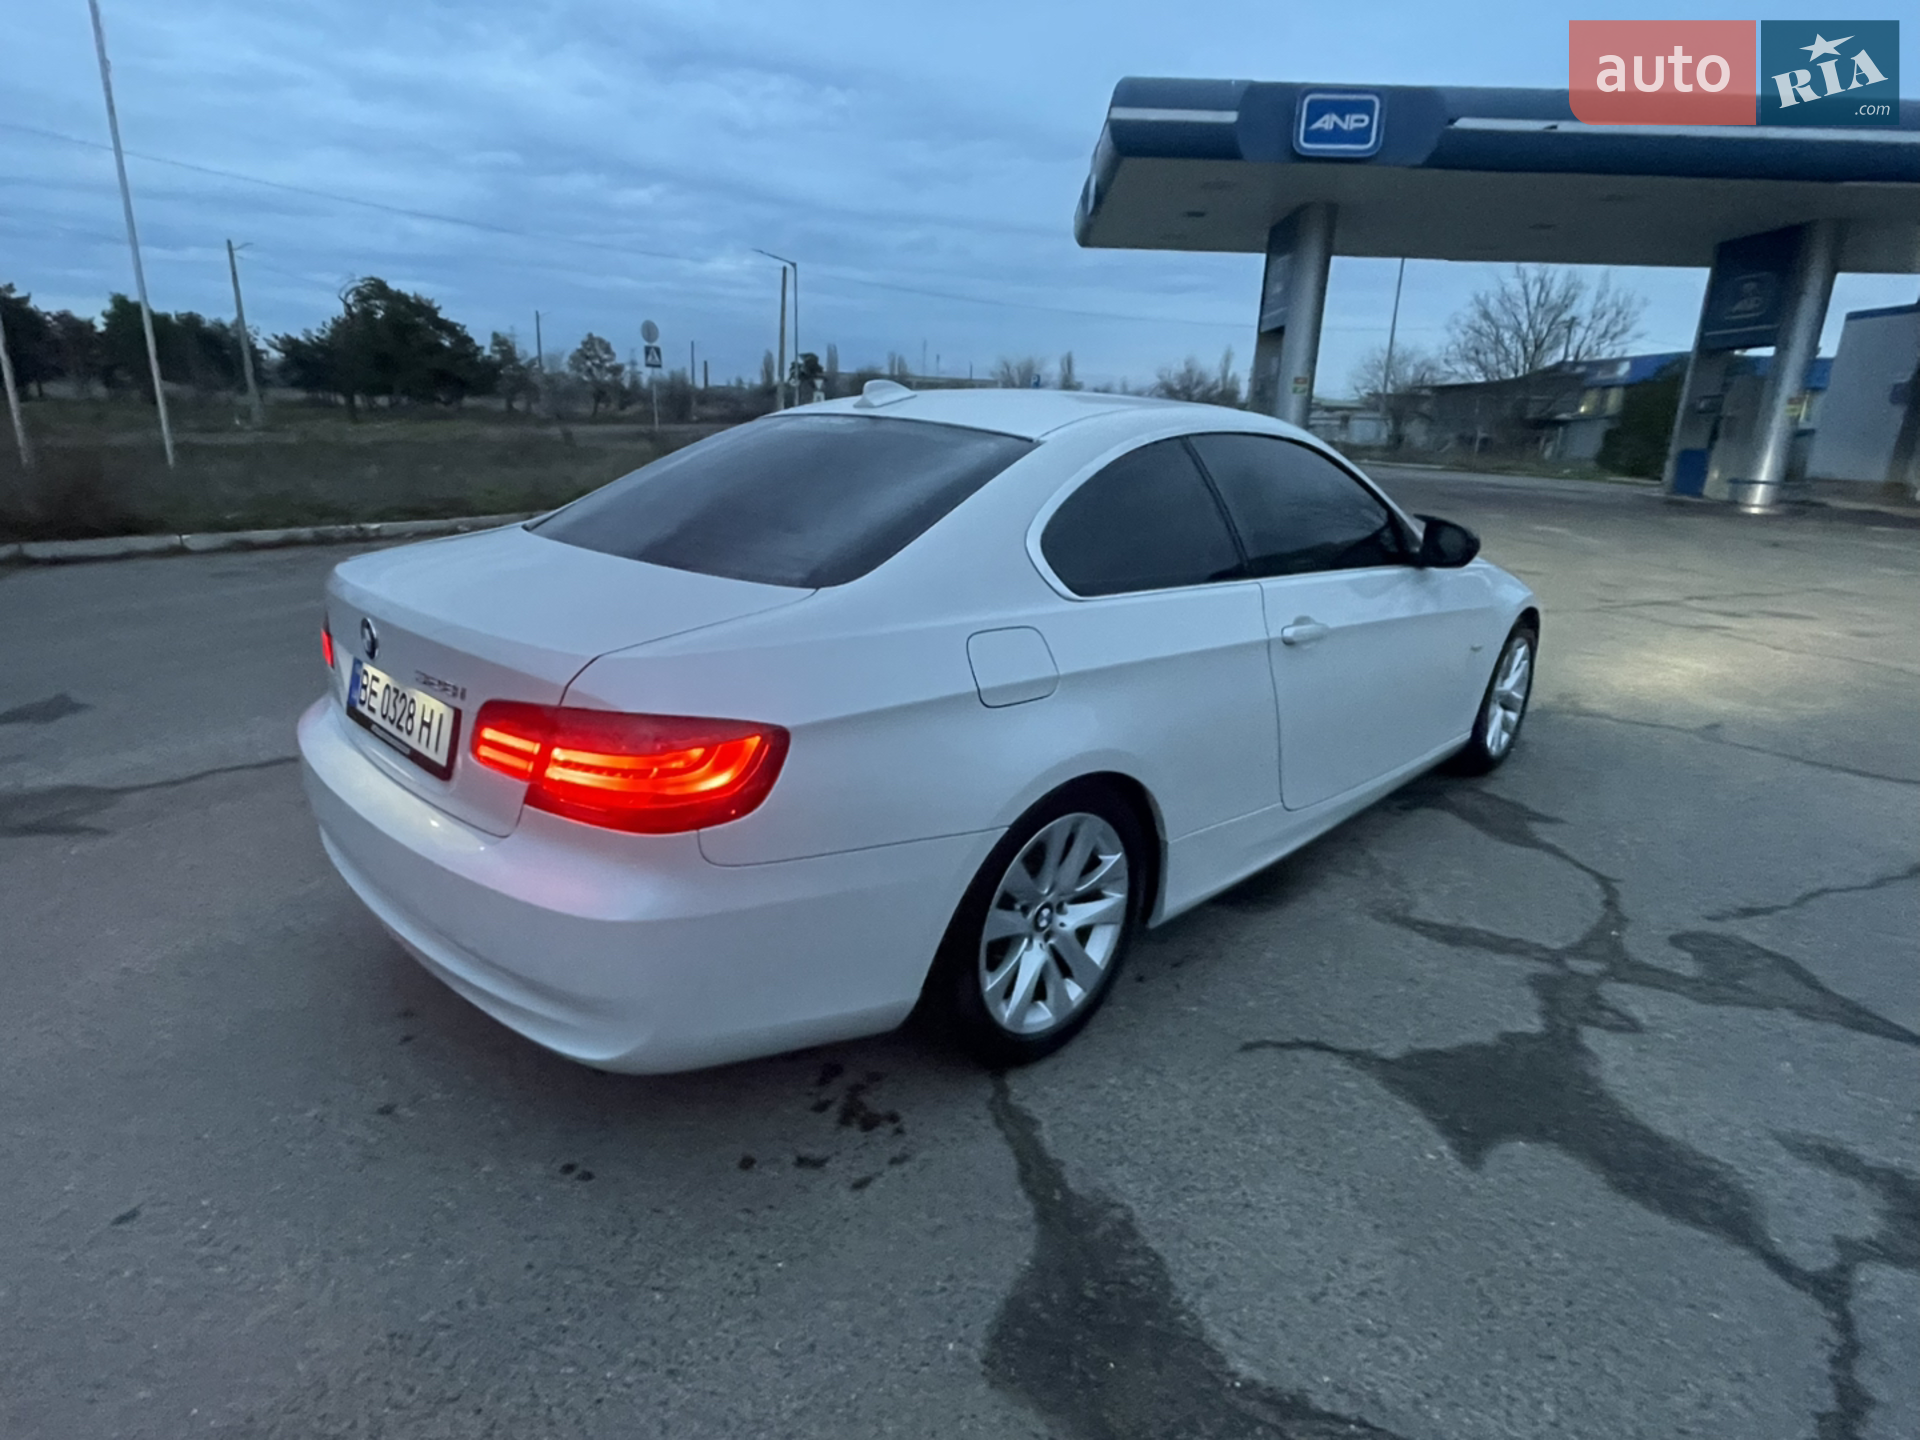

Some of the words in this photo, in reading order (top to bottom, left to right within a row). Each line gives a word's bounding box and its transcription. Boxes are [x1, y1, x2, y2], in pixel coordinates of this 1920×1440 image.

[1308, 113, 1369, 130] ANP
[359, 668, 380, 714] BE
[381, 683, 416, 736] 0328
[418, 703, 444, 754] HI
